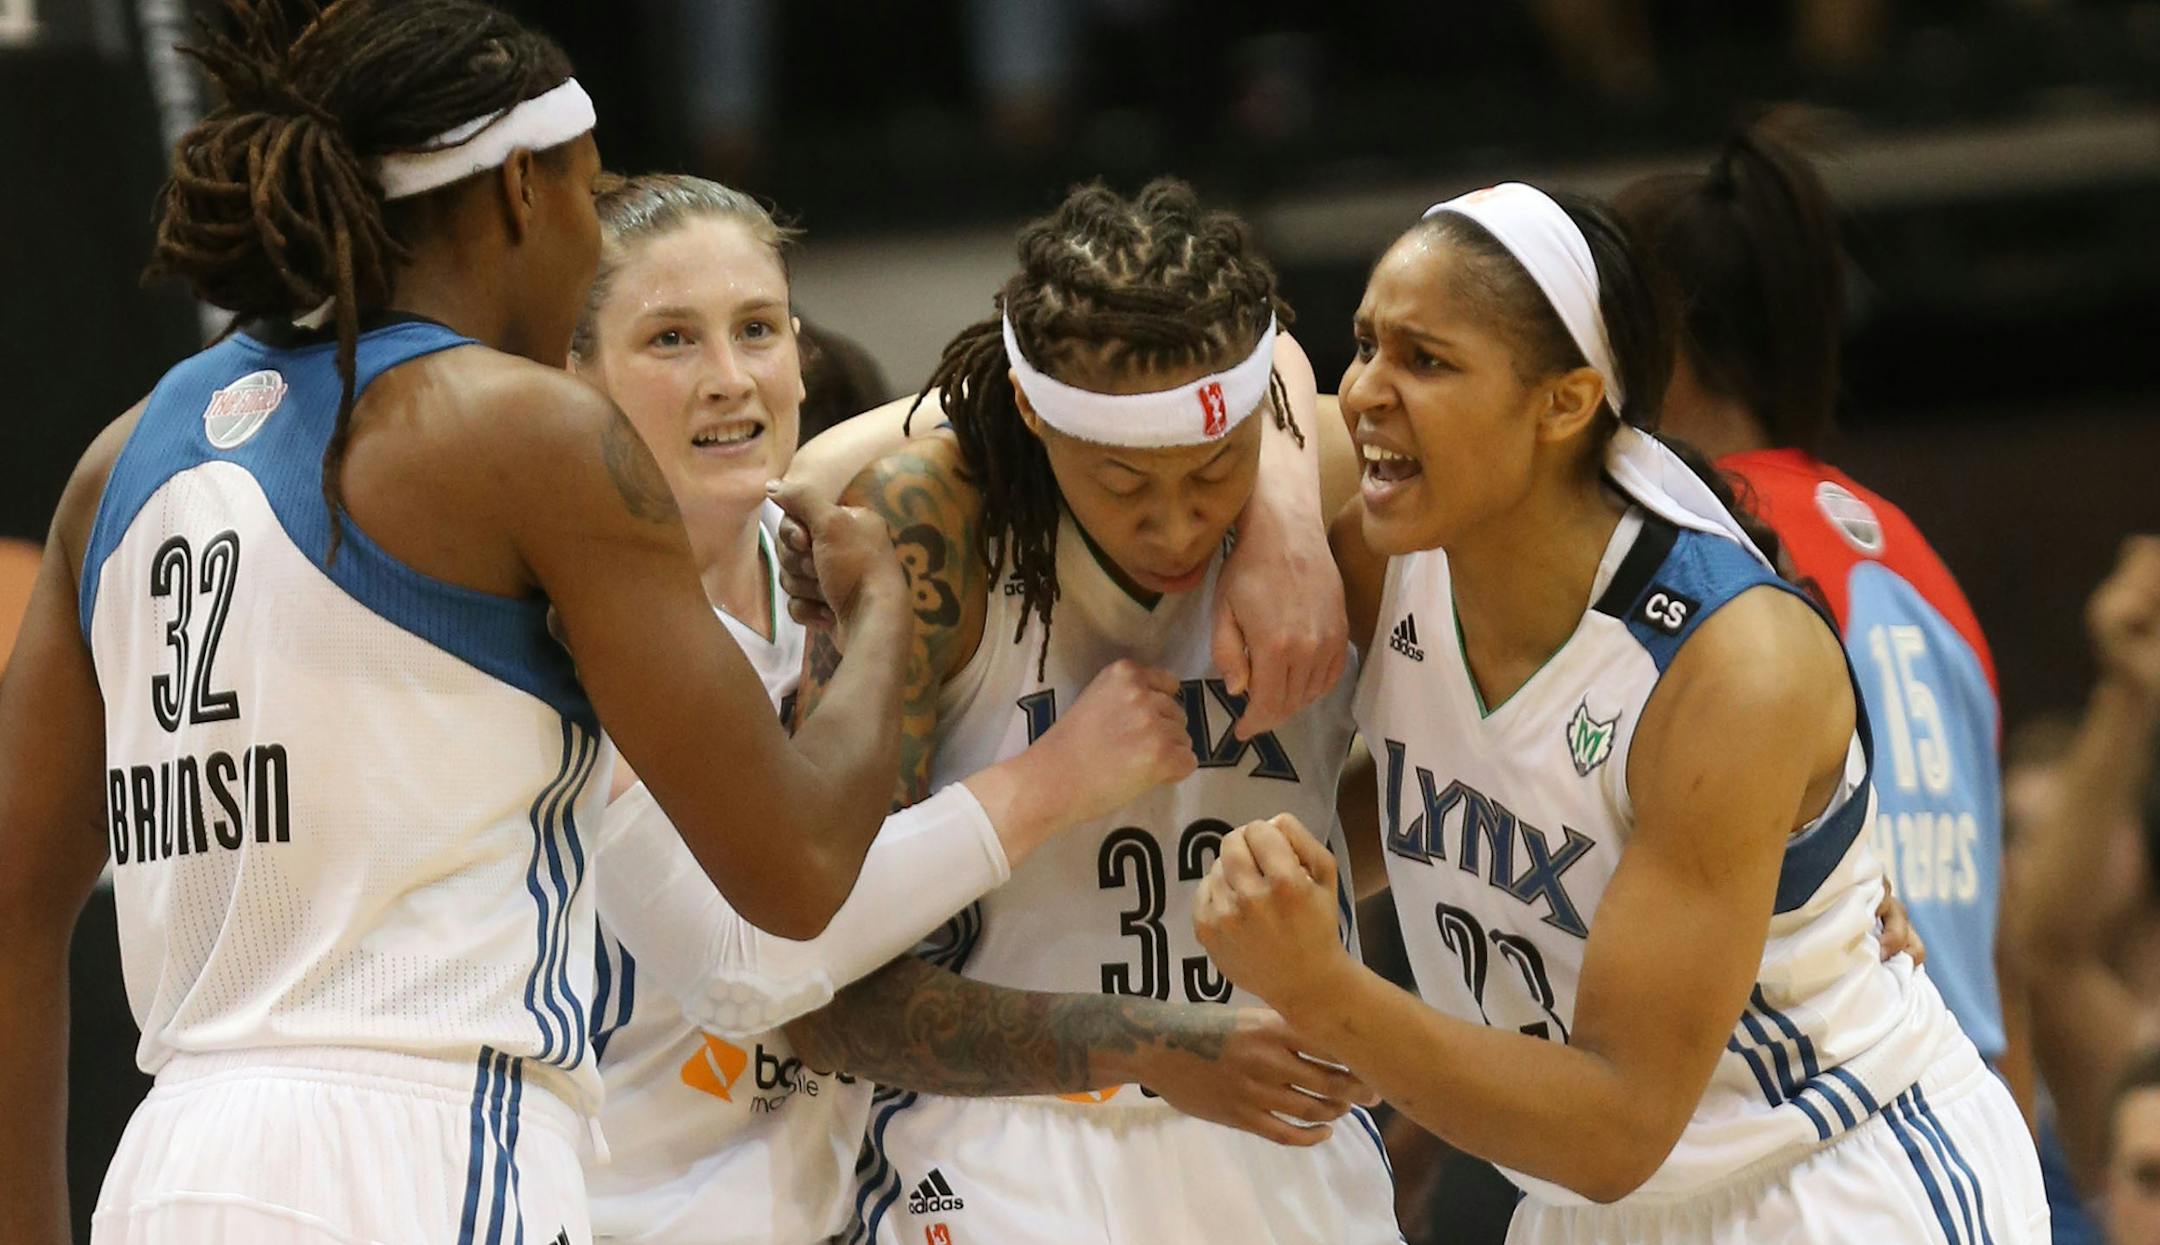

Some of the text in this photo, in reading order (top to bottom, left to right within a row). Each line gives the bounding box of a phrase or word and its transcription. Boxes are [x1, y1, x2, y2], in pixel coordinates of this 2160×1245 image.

[151, 529, 240, 732] 32
[1645, 592, 1687, 629] CS
[1868, 622, 1953, 794] 15
[1385, 738, 1596, 939] LYNX
[750, 1075, 820, 1114] moile
